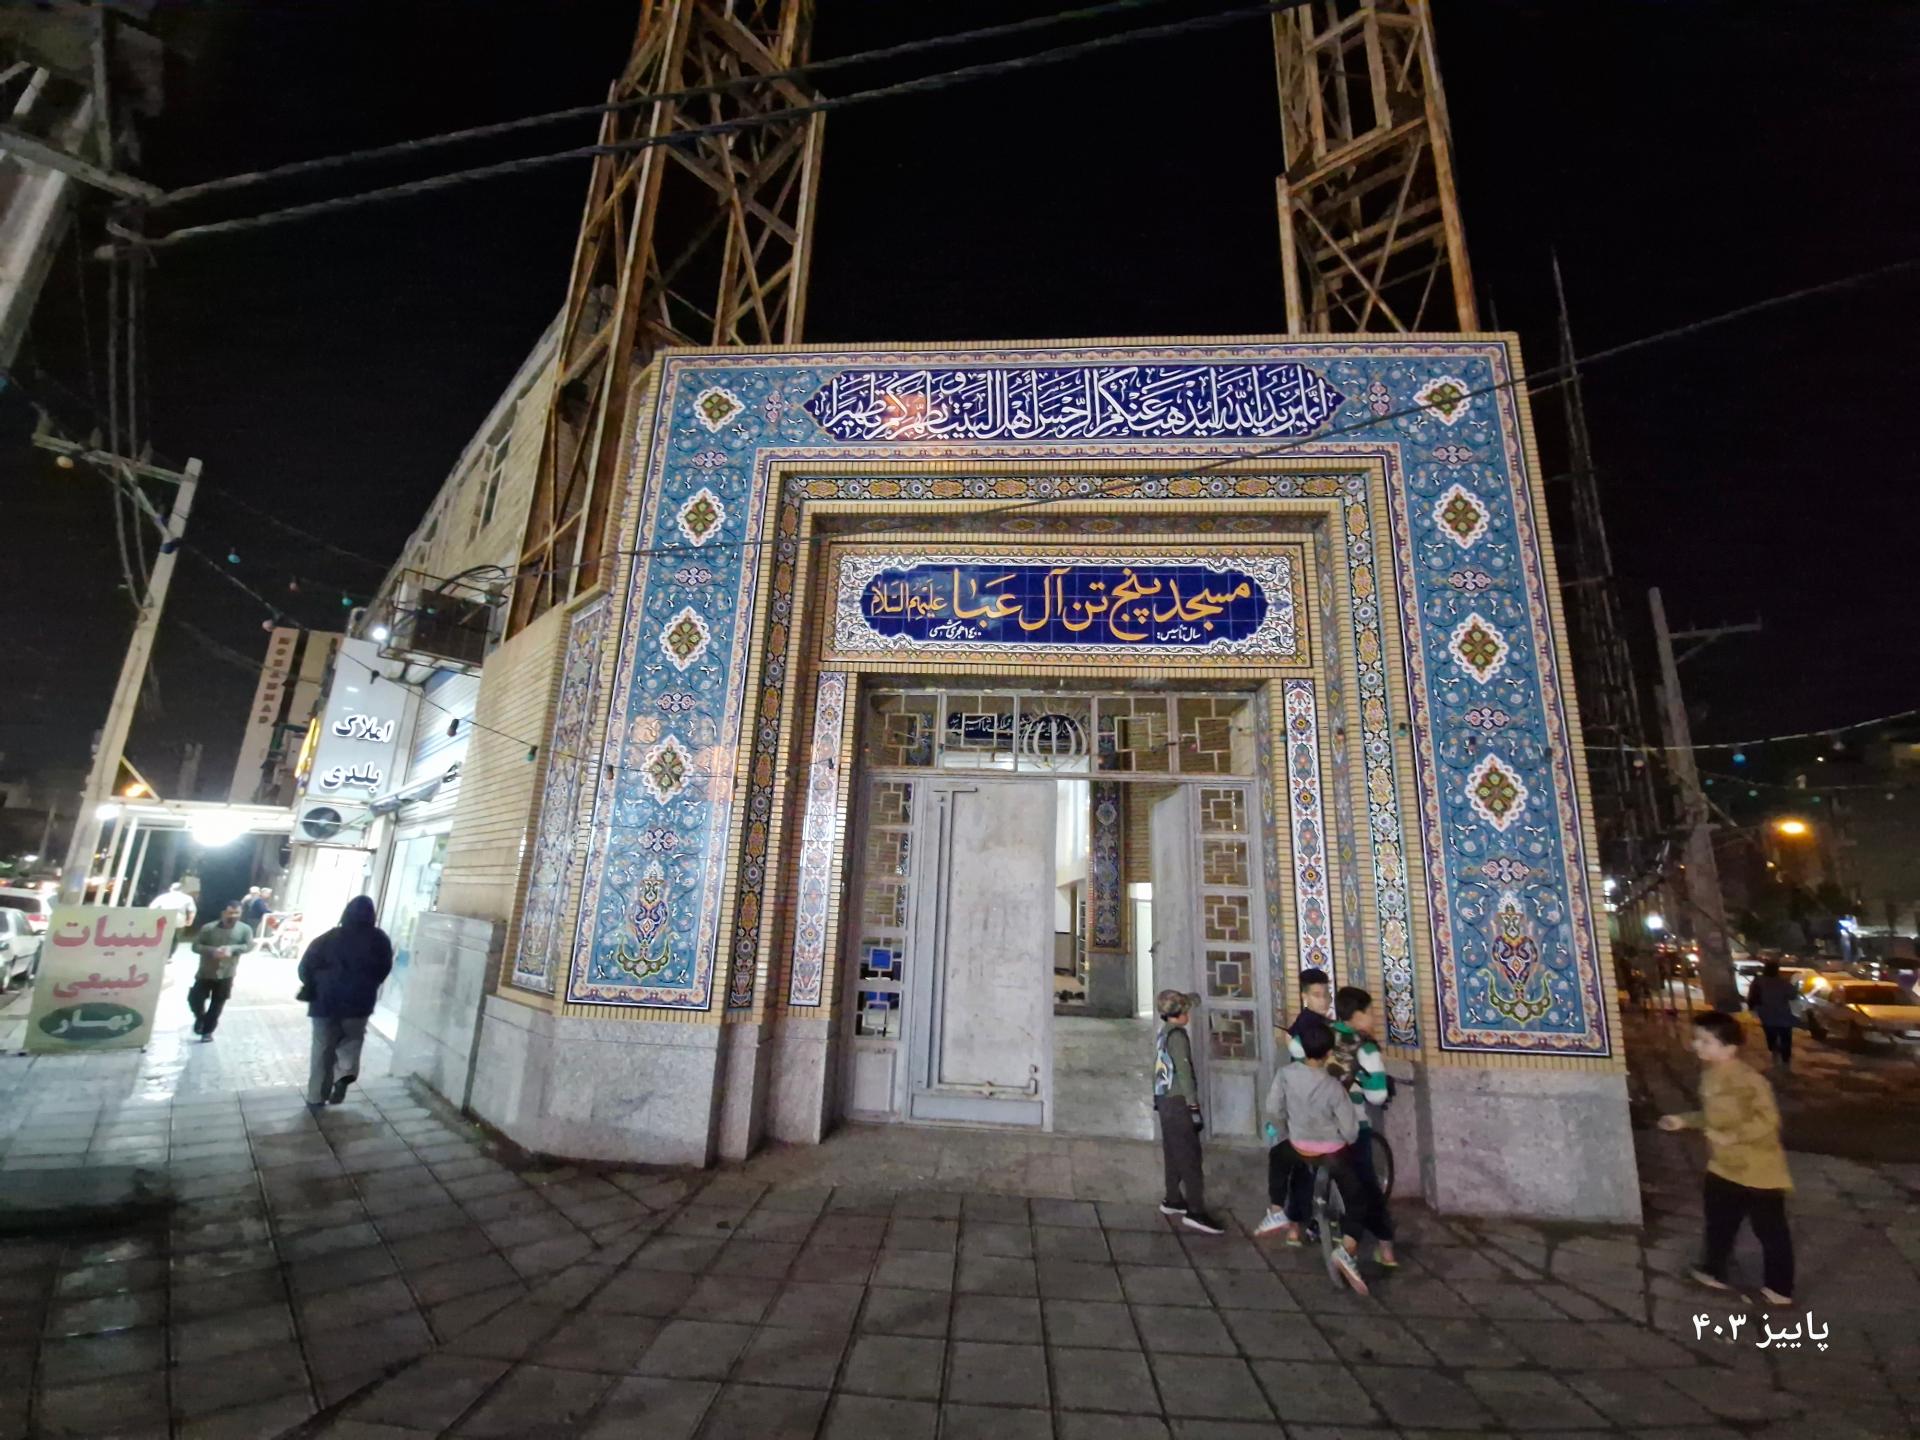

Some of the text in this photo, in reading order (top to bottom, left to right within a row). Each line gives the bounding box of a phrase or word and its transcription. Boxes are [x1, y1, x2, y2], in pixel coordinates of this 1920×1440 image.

[870, 581, 909, 616] السلام
[953, 568, 1022, 628] عبا
[1018, 566, 1071, 631] آل
[1062, 582, 1109, 632] تن
[1109, 568, 1162, 641] پنج
[1153, 578, 1251, 631] مسجد
[1182, 626, 1201, 641] سال
[332, 714, 395, 743] املاک
[320, 761, 383, 793] بلدی
[52, 915, 167, 957] لبنیات
[52, 964, 149, 998] طبیعی
[51, 1008, 134, 1034] بهار
